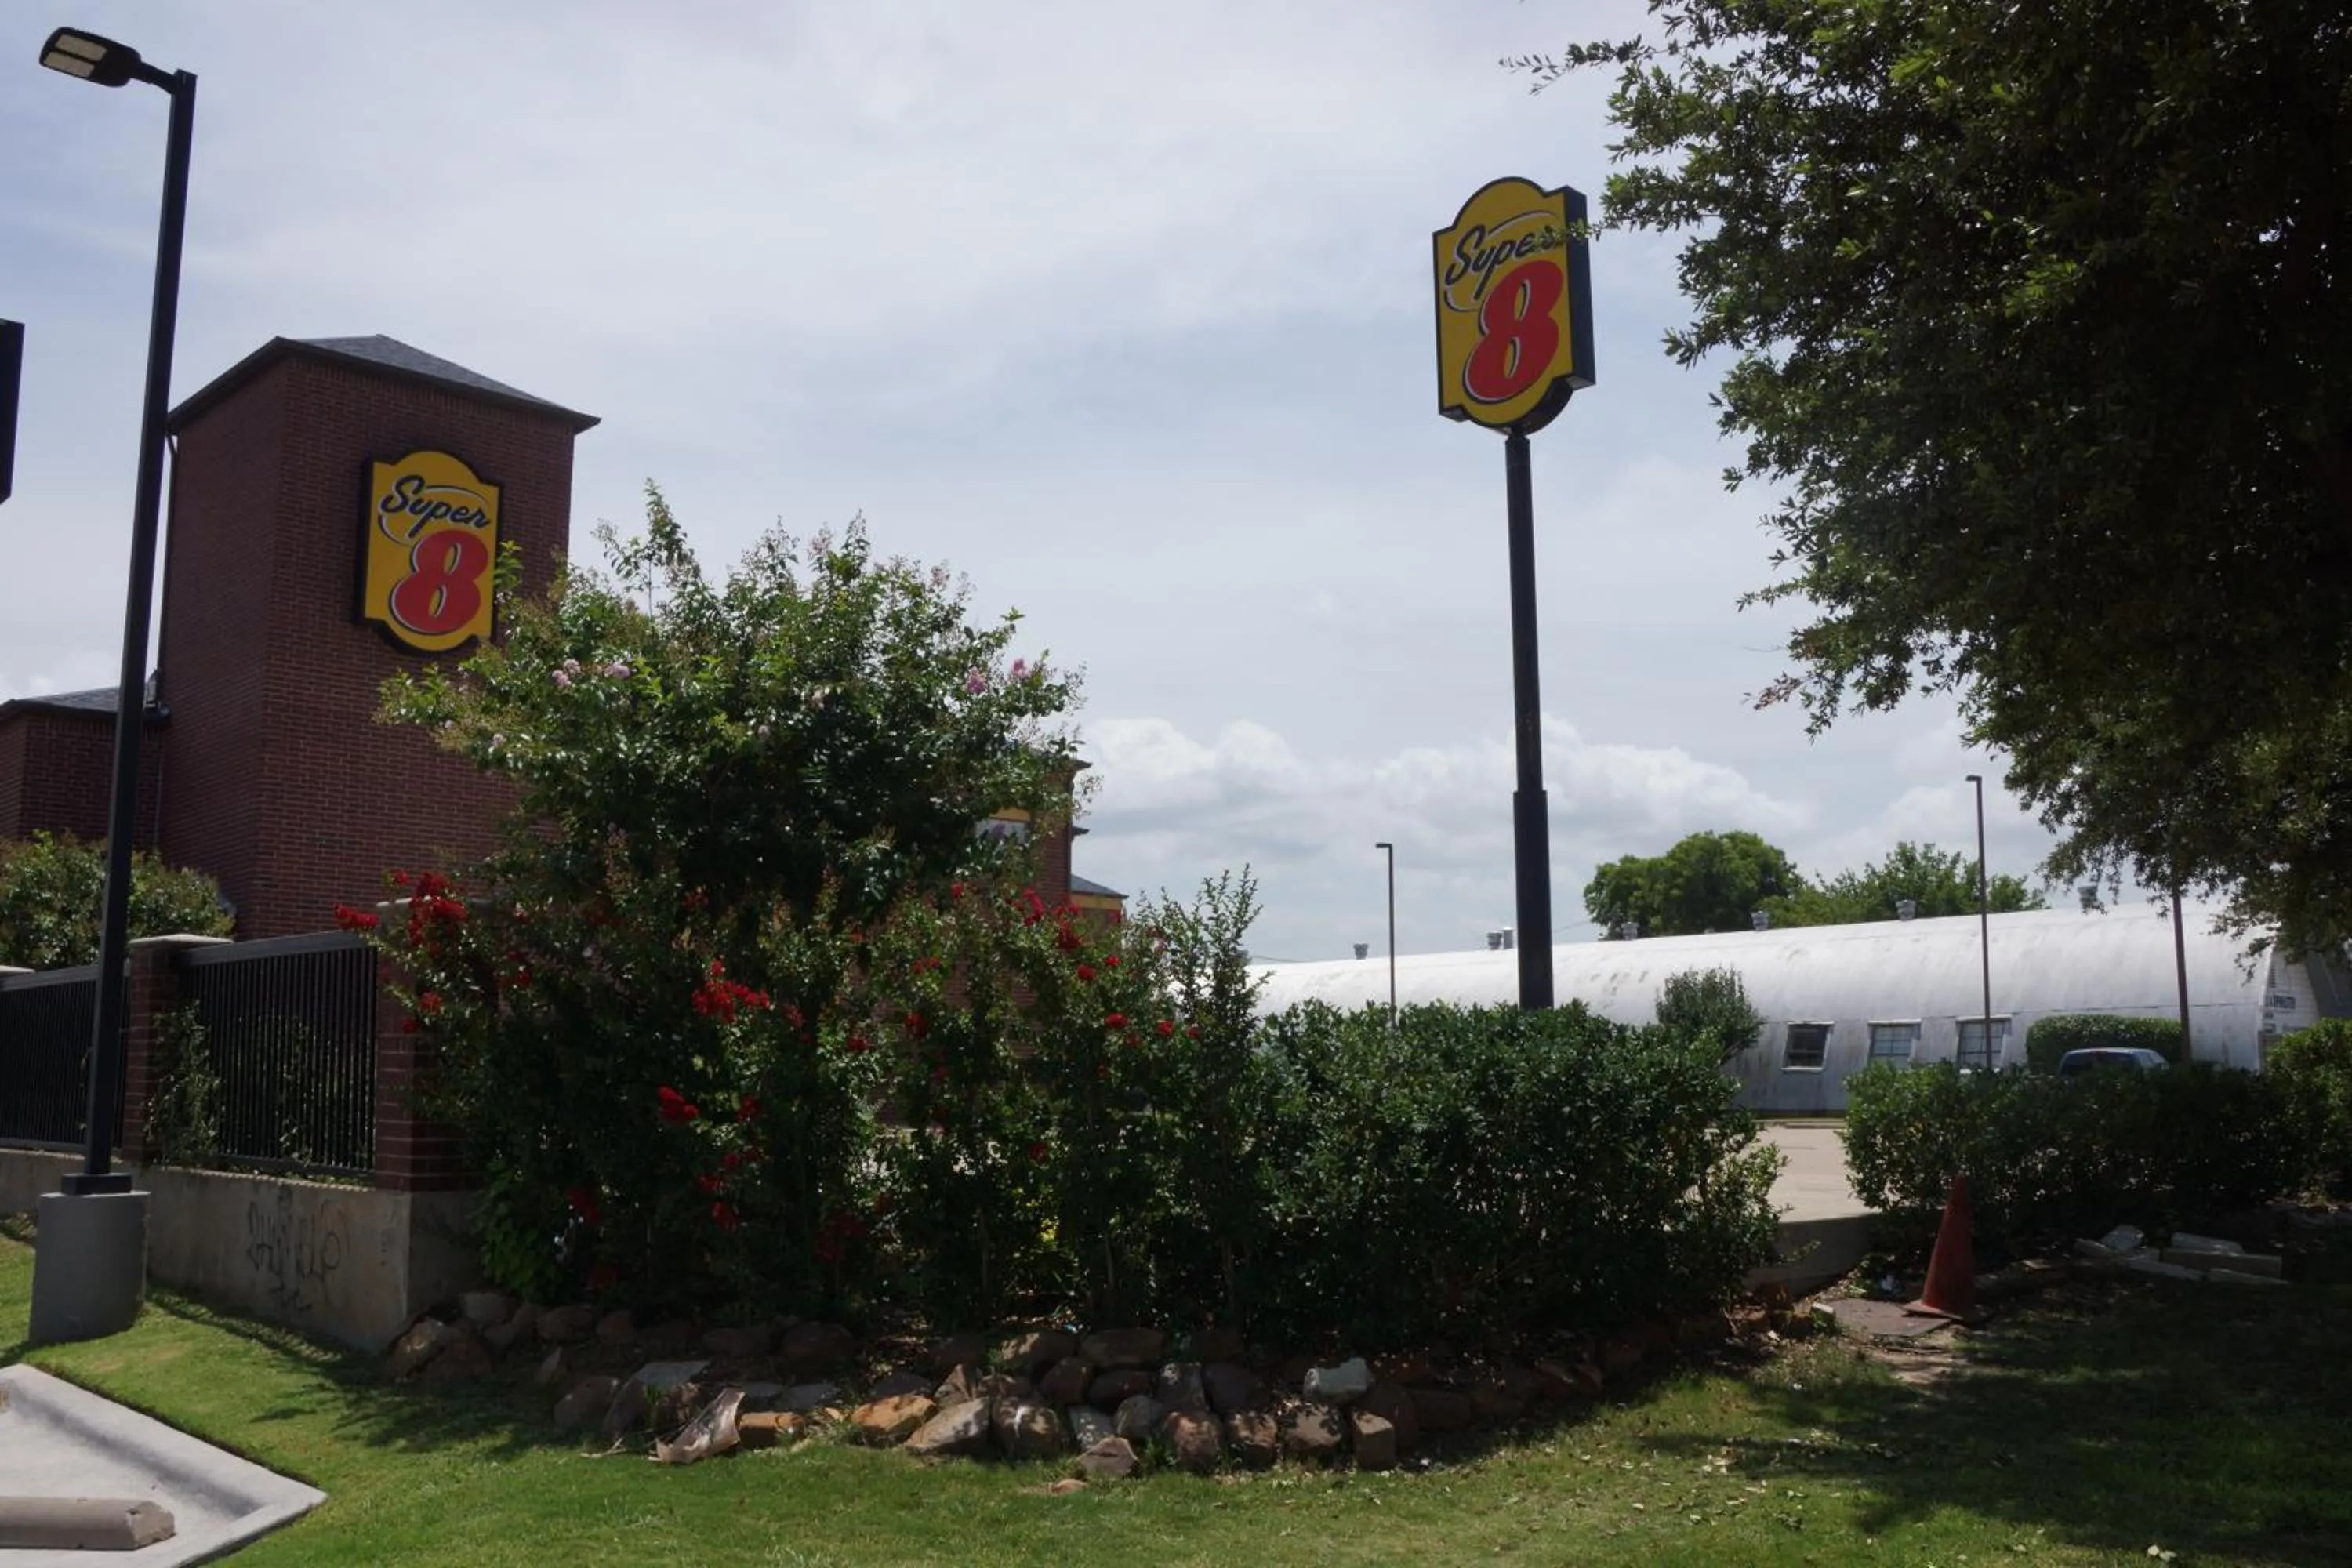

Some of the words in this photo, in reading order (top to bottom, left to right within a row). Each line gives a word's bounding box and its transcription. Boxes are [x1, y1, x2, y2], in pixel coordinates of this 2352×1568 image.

[1463, 260, 1564, 404] 8
[380, 474, 492, 538] Super
[389, 530, 489, 636] 8
